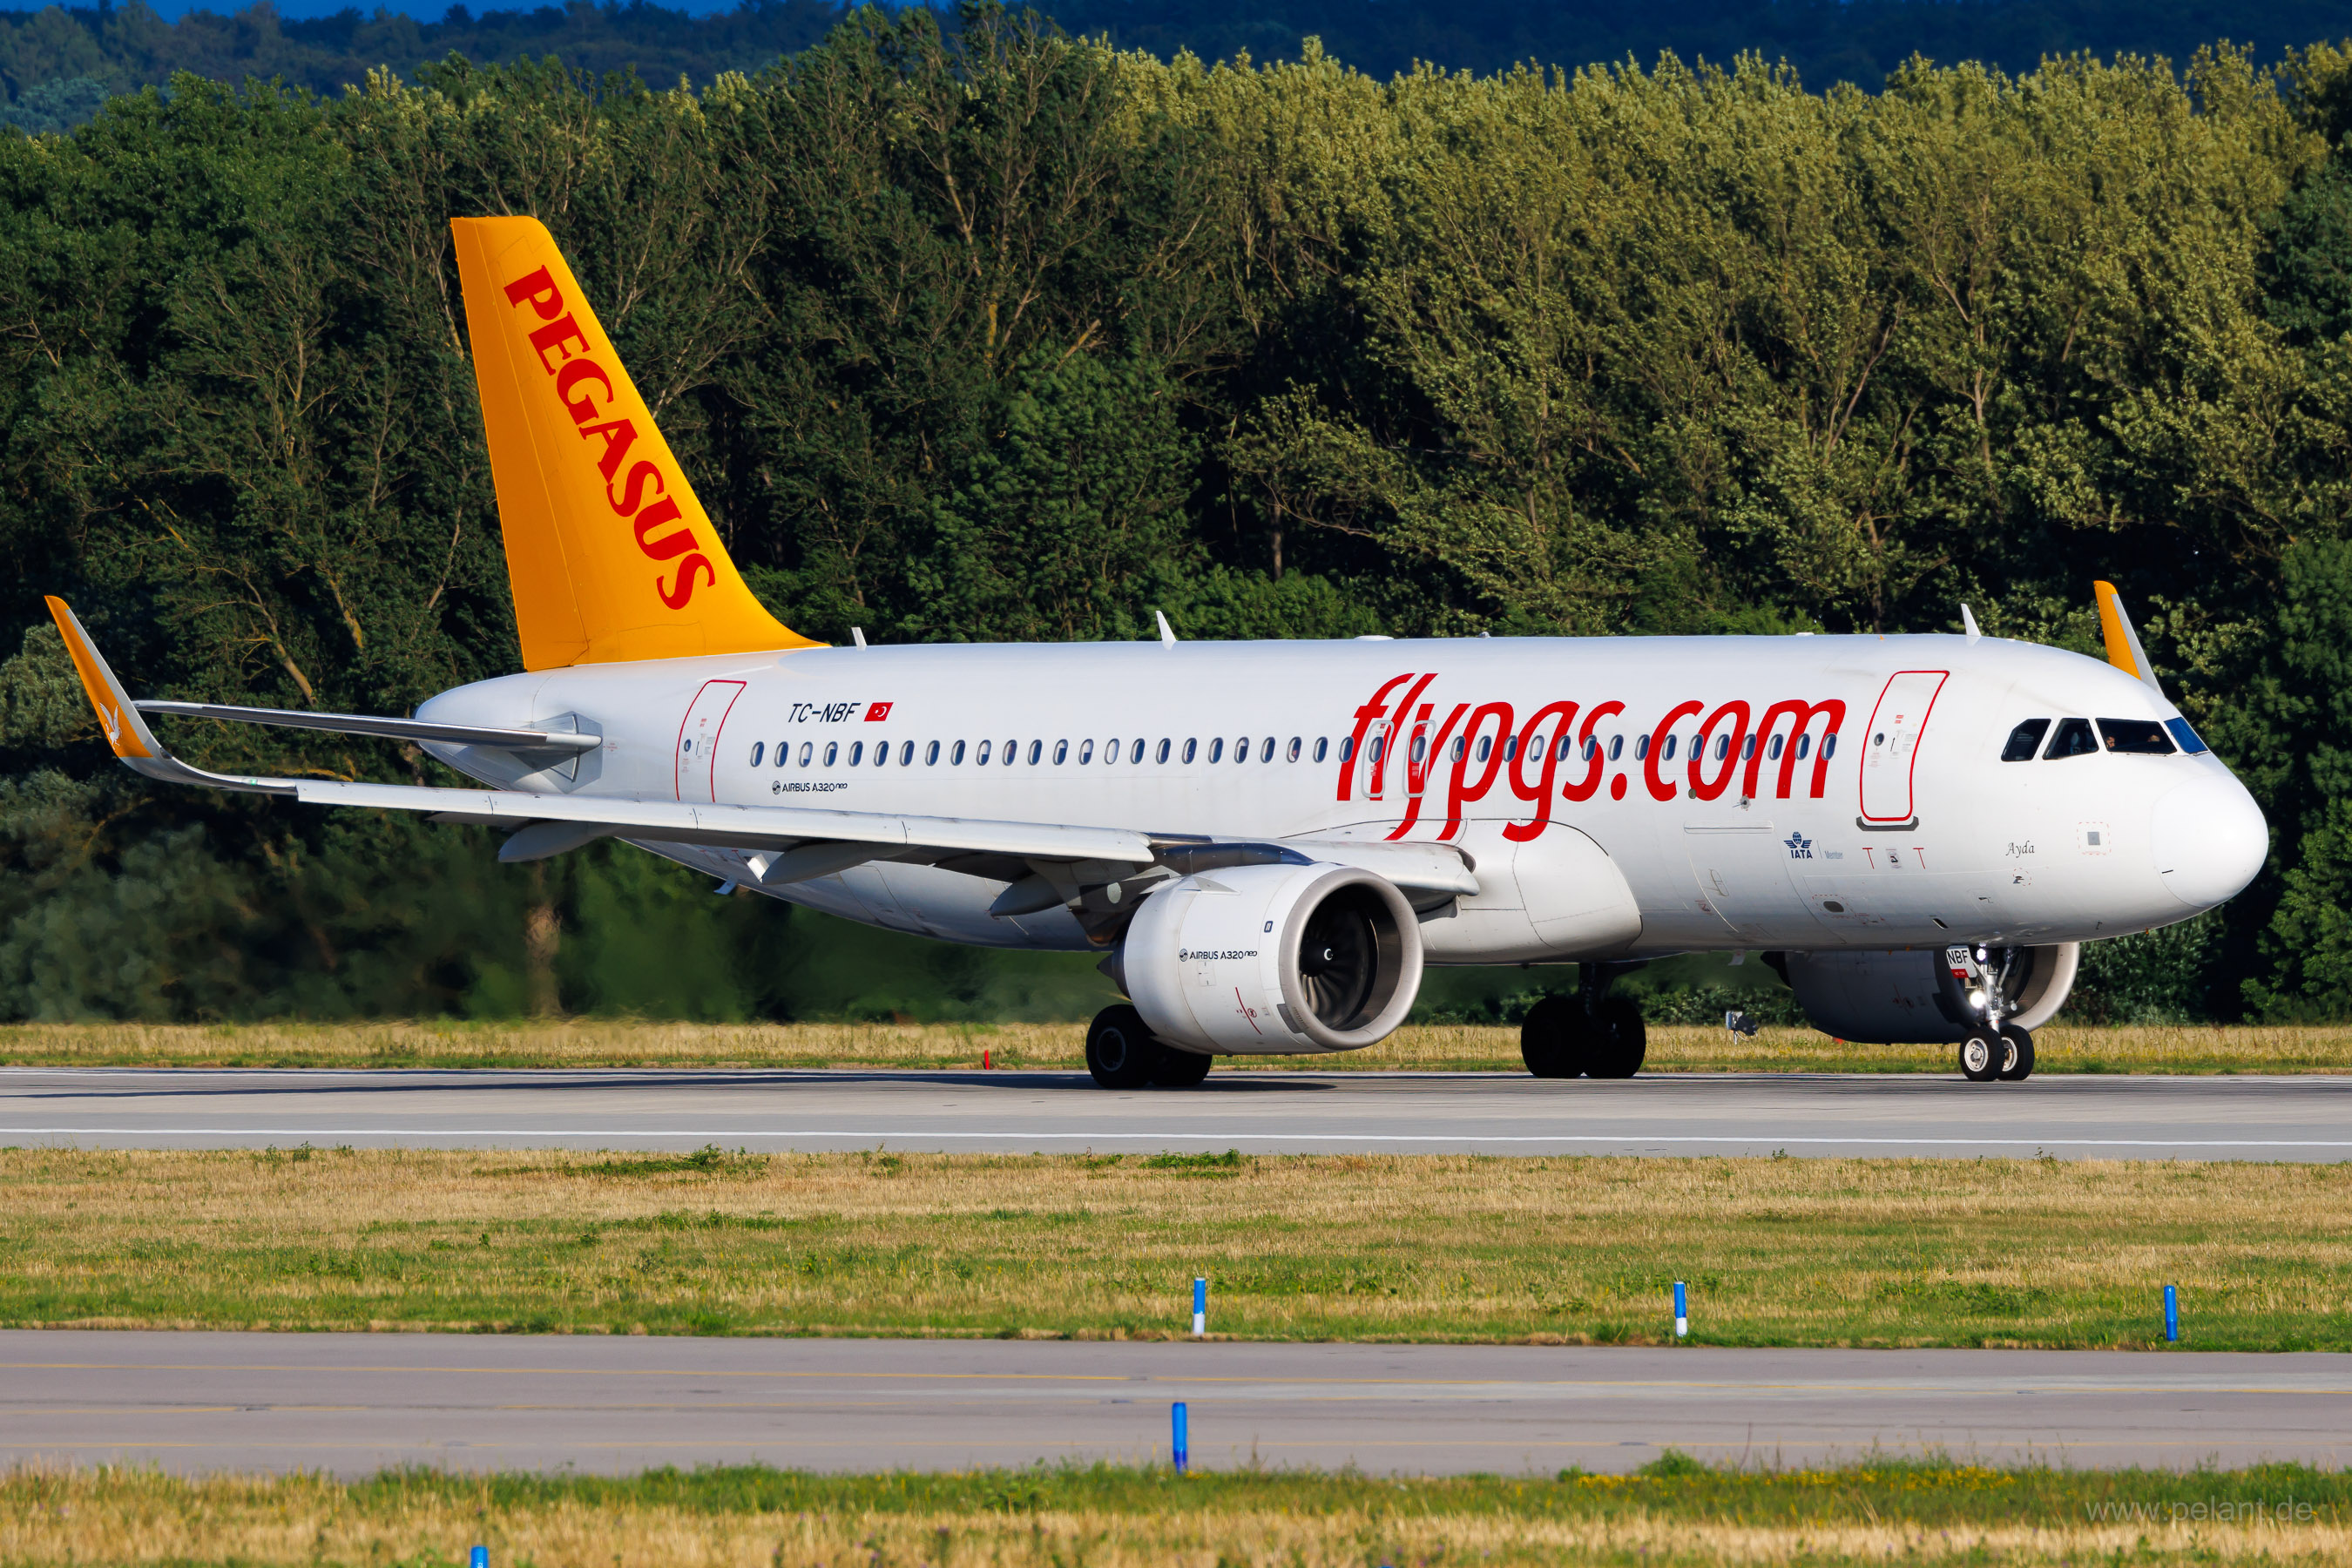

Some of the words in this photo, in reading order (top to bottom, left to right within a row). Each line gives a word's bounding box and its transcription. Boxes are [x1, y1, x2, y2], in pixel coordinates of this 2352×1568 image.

[504, 264, 716, 611] PEGASUS
[787, 702, 862, 724] TC-NBF
[1336, 672, 1847, 842] flypgs.com
[782, 782, 810, 792] AIRBUS
[1790, 849, 1813, 859] IATA
[2005, 840, 2035, 858] Ayda
[1947, 950, 1968, 964] NBF
